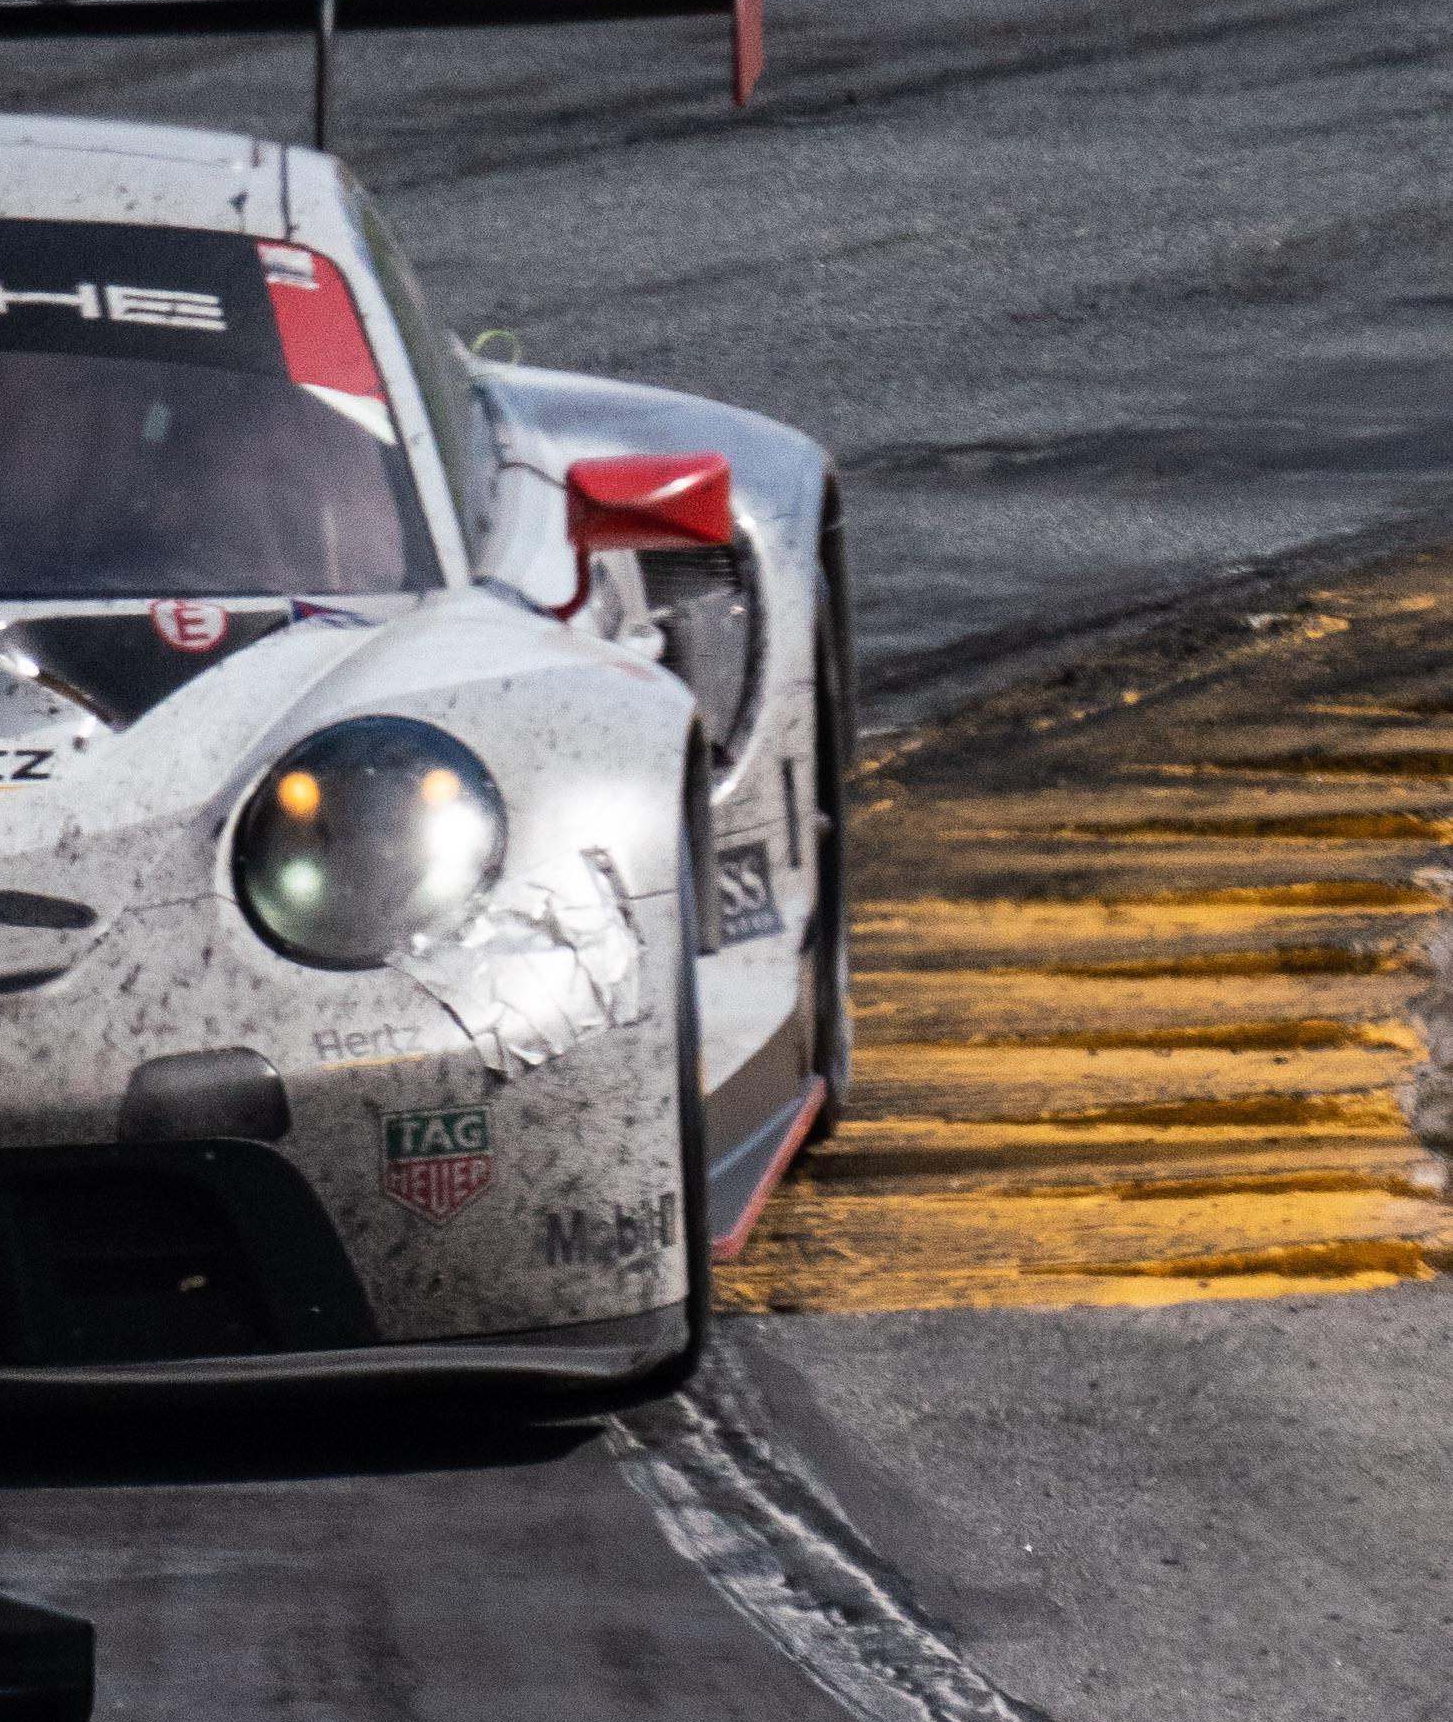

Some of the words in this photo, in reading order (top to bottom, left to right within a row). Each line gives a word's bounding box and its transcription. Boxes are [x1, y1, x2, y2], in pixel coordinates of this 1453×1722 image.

[311, 1023, 424, 1061] Hertz
[400, 1115, 482, 1151] TAG
[388, 1159, 487, 1215] HEUER
